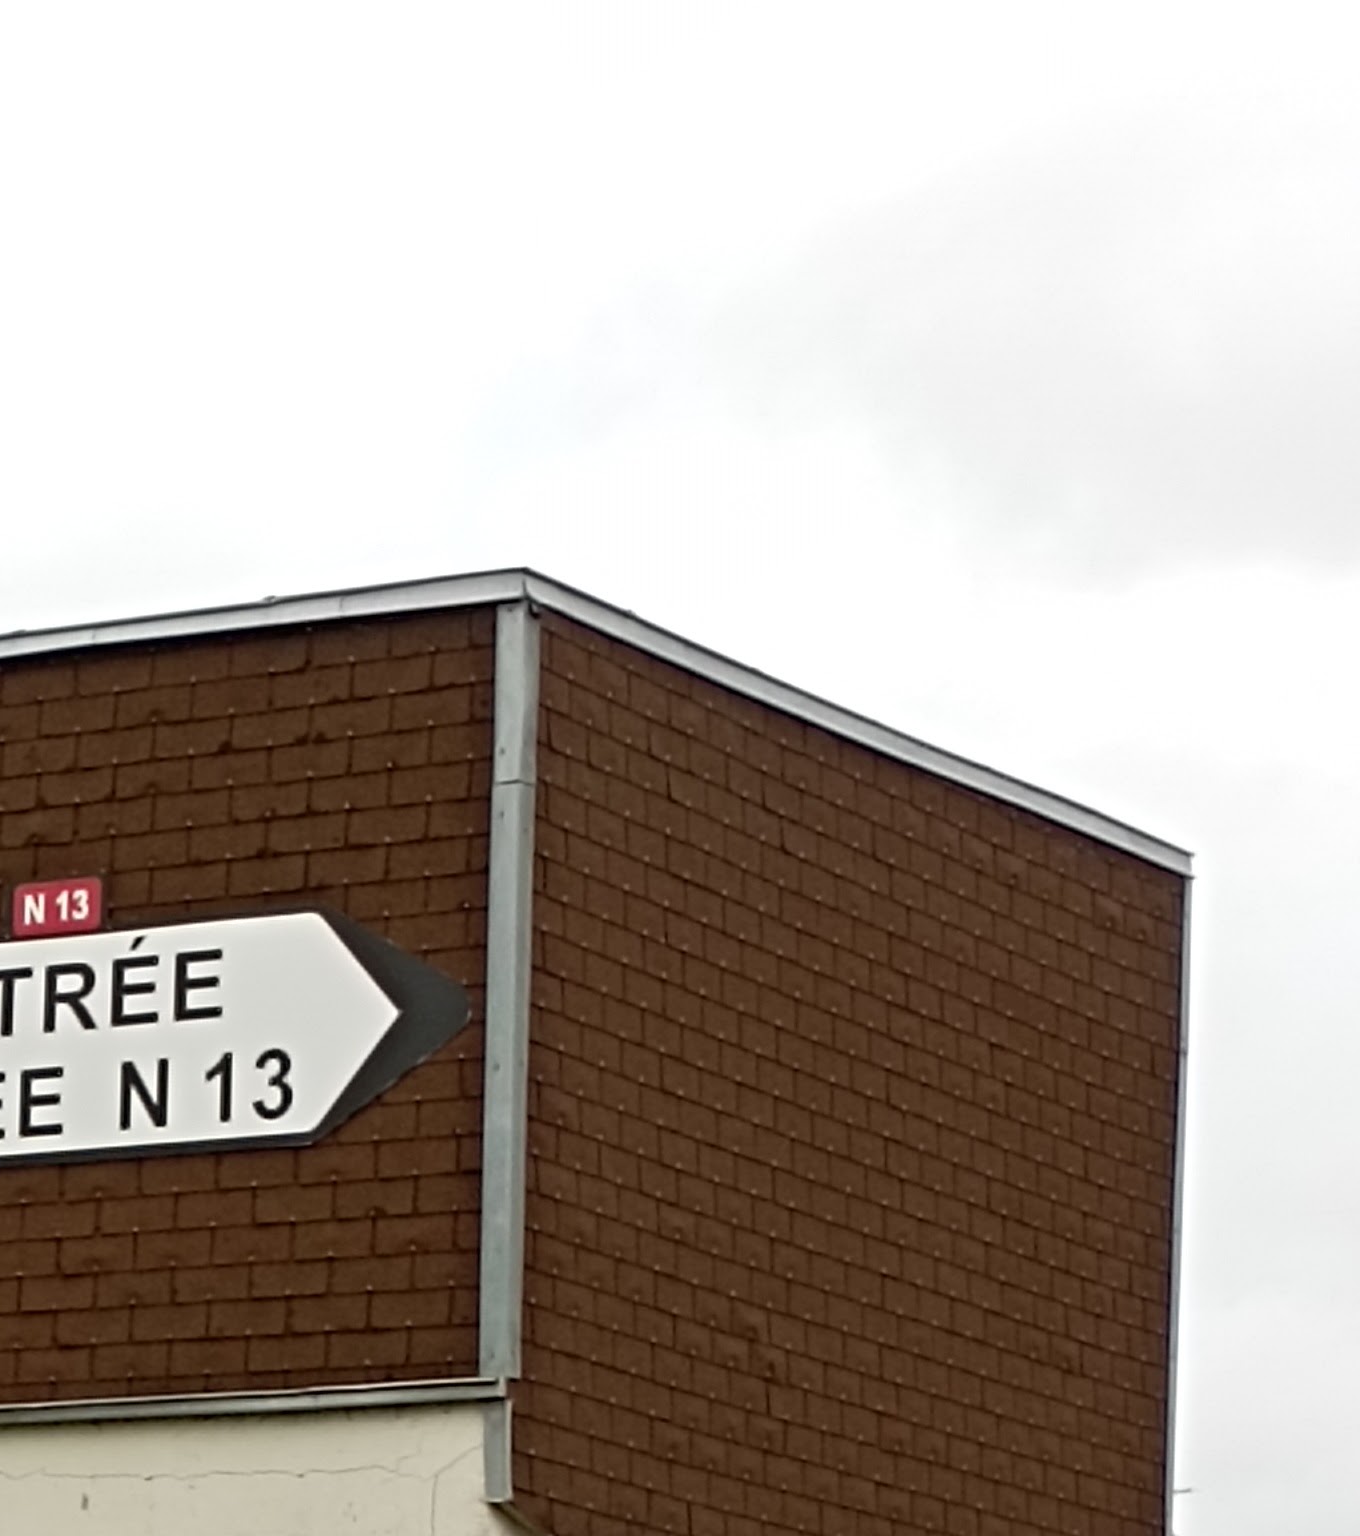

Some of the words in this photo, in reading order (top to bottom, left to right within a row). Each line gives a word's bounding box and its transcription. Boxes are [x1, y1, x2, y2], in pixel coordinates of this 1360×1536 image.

[23, 892, 46, 926] N
[55, 888, 90, 921] 13
[118, 1057, 170, 1131] N
[204, 1048, 295, 1123] 13
